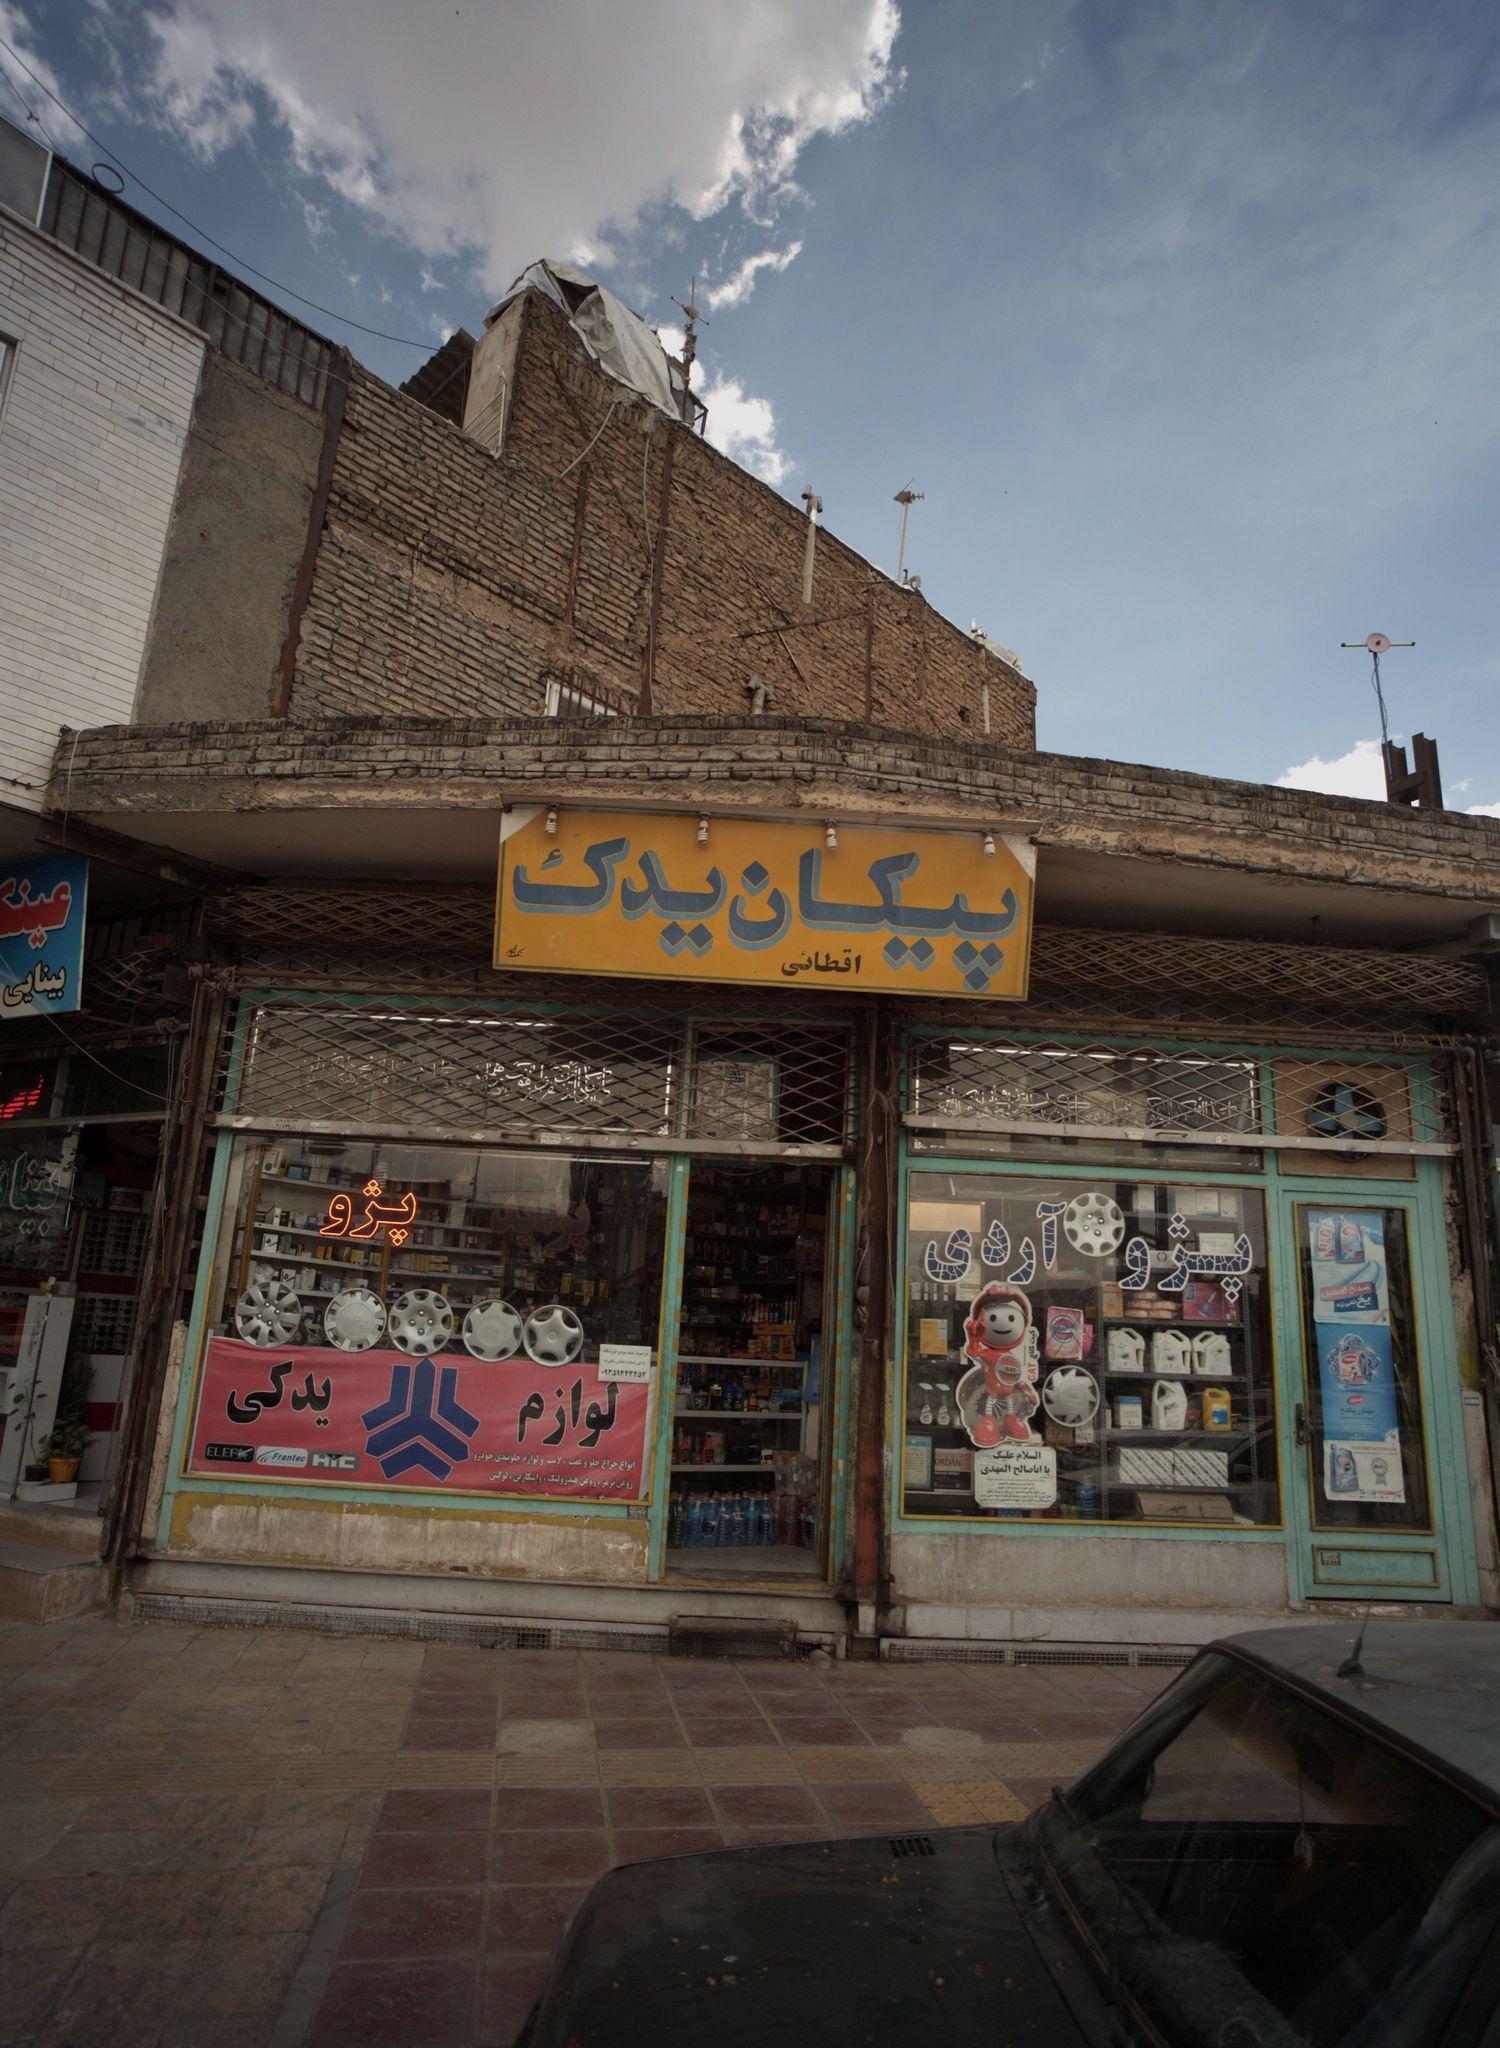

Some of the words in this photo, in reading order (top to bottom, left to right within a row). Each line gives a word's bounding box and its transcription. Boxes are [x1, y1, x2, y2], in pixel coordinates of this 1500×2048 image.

[727, 848, 1022, 993] پیکان
[319, 1179, 418, 1247] پژو
[925, 1201, 1068, 1285] آردی
[1119, 1212, 1253, 1303] پژو
[225, 1359, 334, 1428] یدکی
[1028, 1363, 1038, 1381] GAT
[516, 1377, 620, 1449] لوازم
[271, 1452, 306, 1463] Frantec
[1016, 1451, 1042, 1461] السلام
